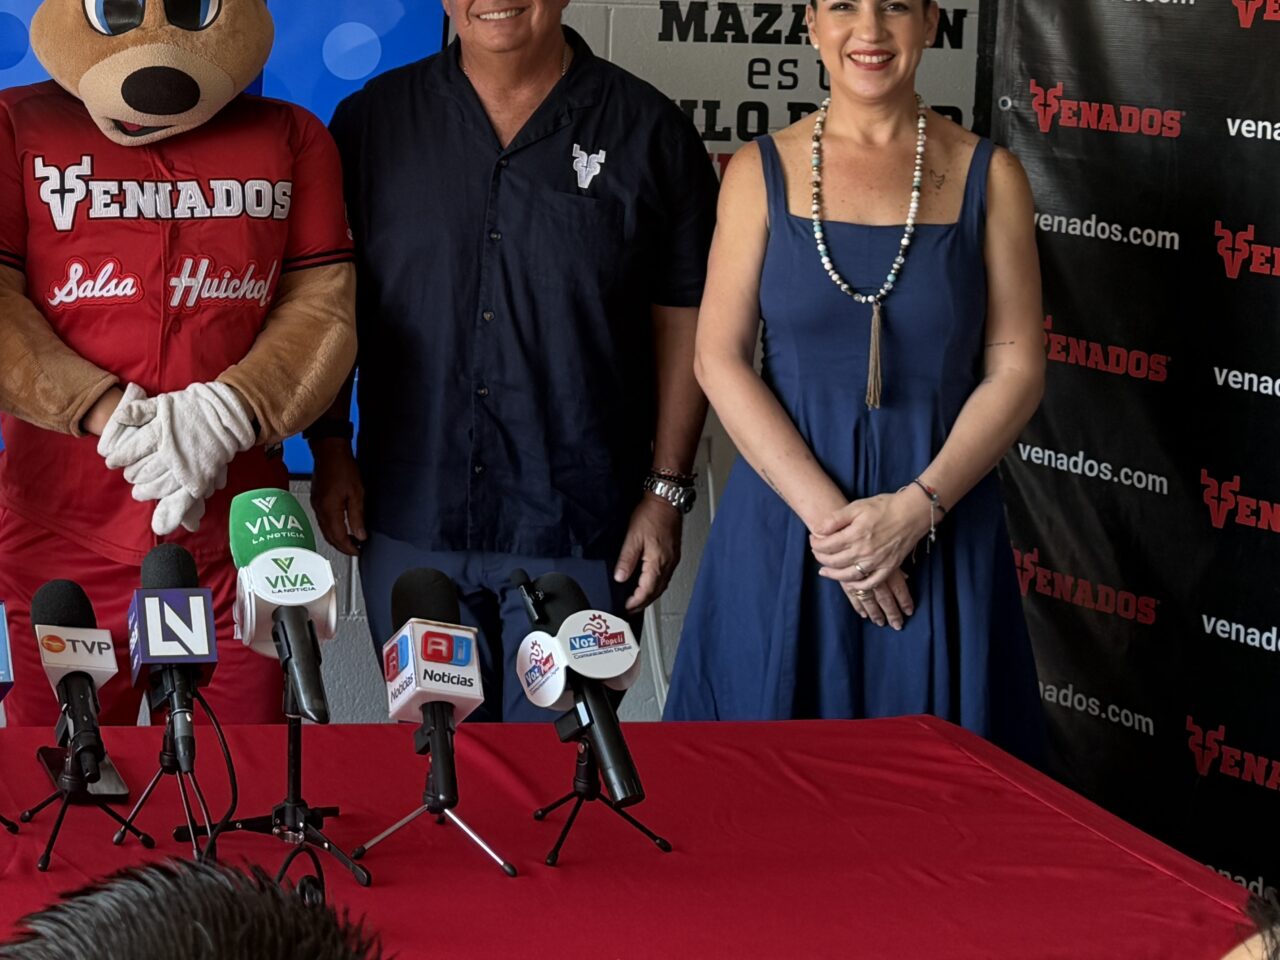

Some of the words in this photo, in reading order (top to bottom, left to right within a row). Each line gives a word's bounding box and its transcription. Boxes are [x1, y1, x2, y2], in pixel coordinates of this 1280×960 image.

[747, 57, 798, 90] es
[1029, 79, 1182, 138] VENADOS
[33, 154, 293, 232] VENADOS
[47, 261, 138, 306] Salsa
[169, 257, 279, 308] Huichol
[1043, 315, 1170, 382] ENADOS
[1018, 442, 1169, 495] venados.com
[245, 514, 304, 535] VIVA
[252, 536, 265, 544] LA
[266, 531, 305, 541] NOTICIA
[265, 573, 315, 589] VIVA
[66, 638, 112, 656] TVP
[144, 595, 210, 657] LN
[570, 636, 597, 650] Voz
[422, 668, 475, 688] Noticias
[1039, 681, 1155, 736] ados.com
